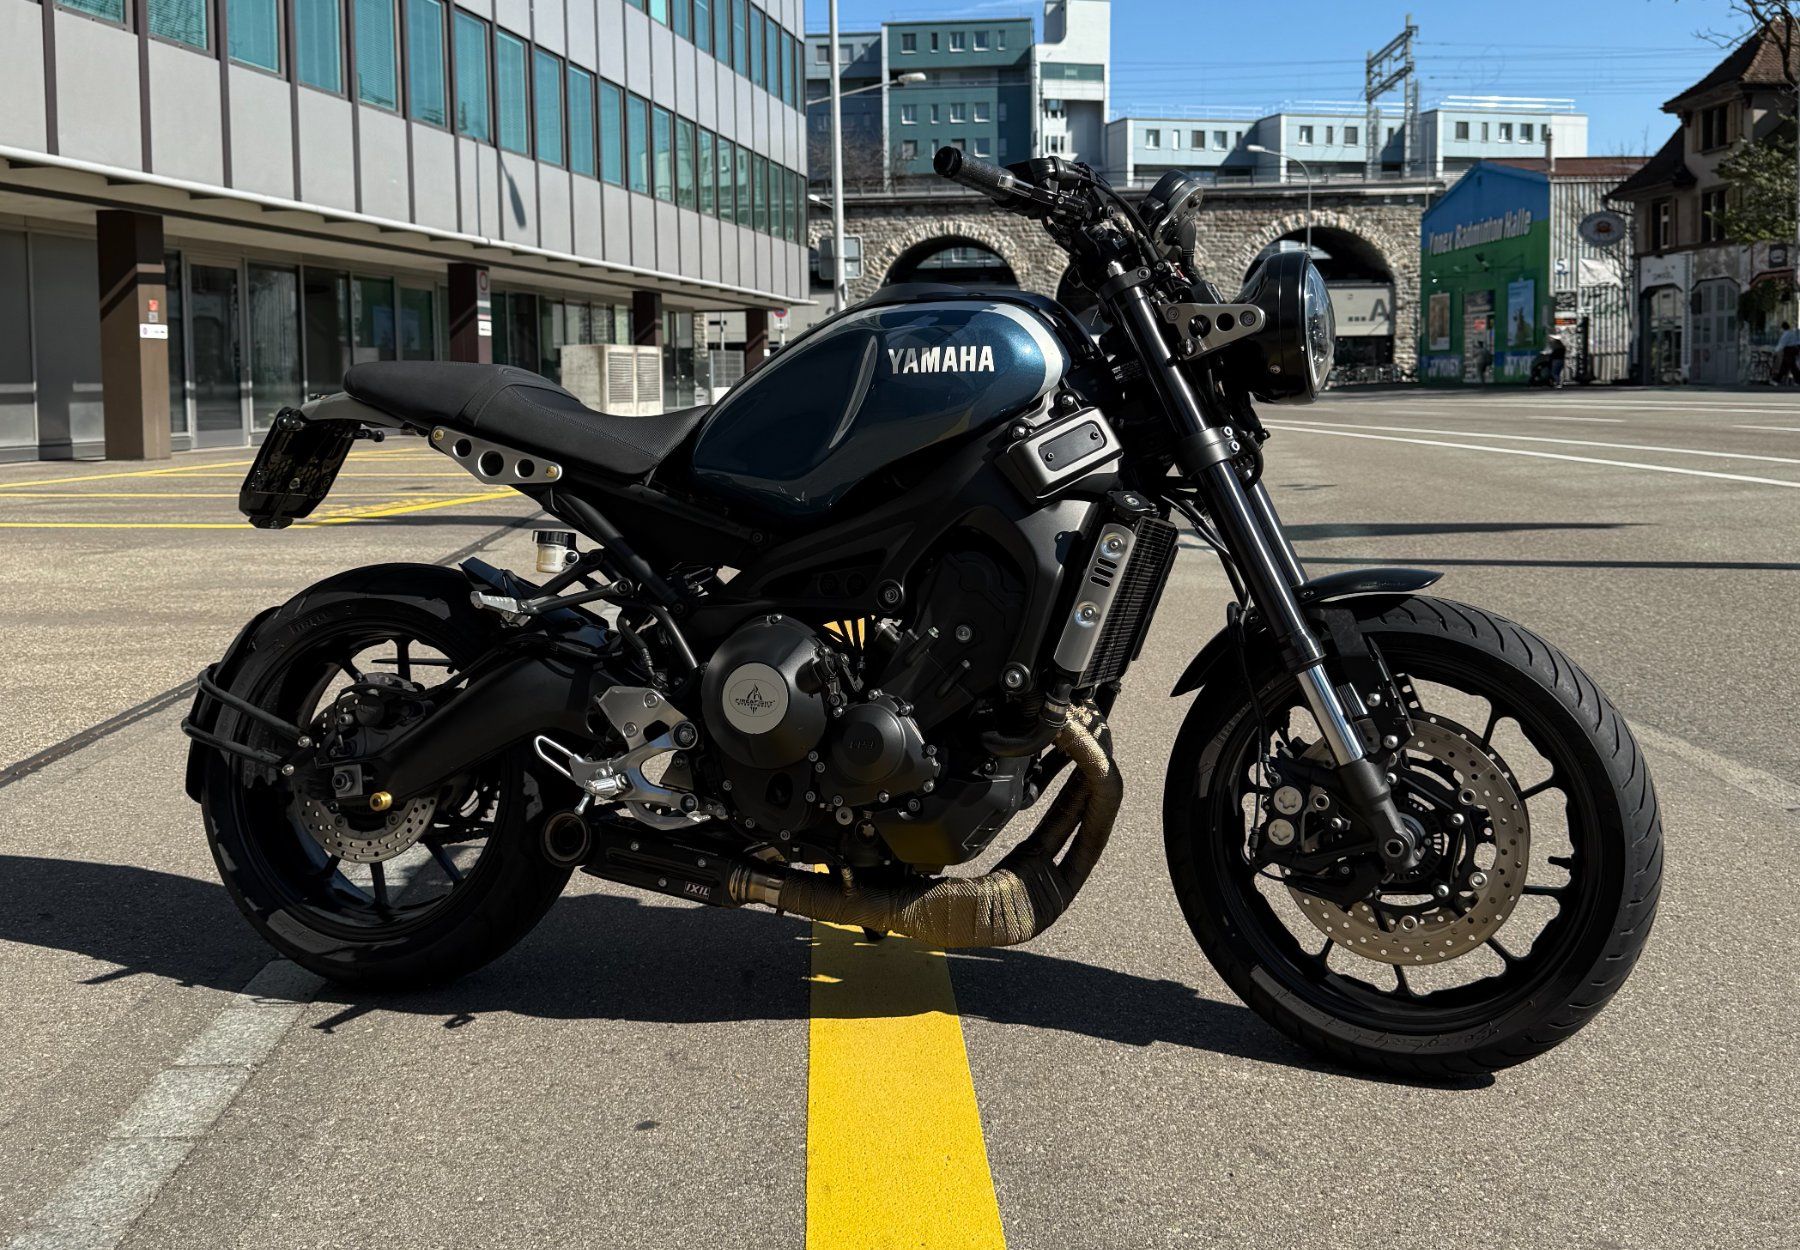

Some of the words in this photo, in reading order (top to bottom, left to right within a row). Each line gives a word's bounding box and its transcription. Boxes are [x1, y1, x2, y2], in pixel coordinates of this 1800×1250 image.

[1503, 207, 1532, 240] Halle
[888, 345, 995, 375] YAMAHA
[685, 883, 709, 896] IXIL
